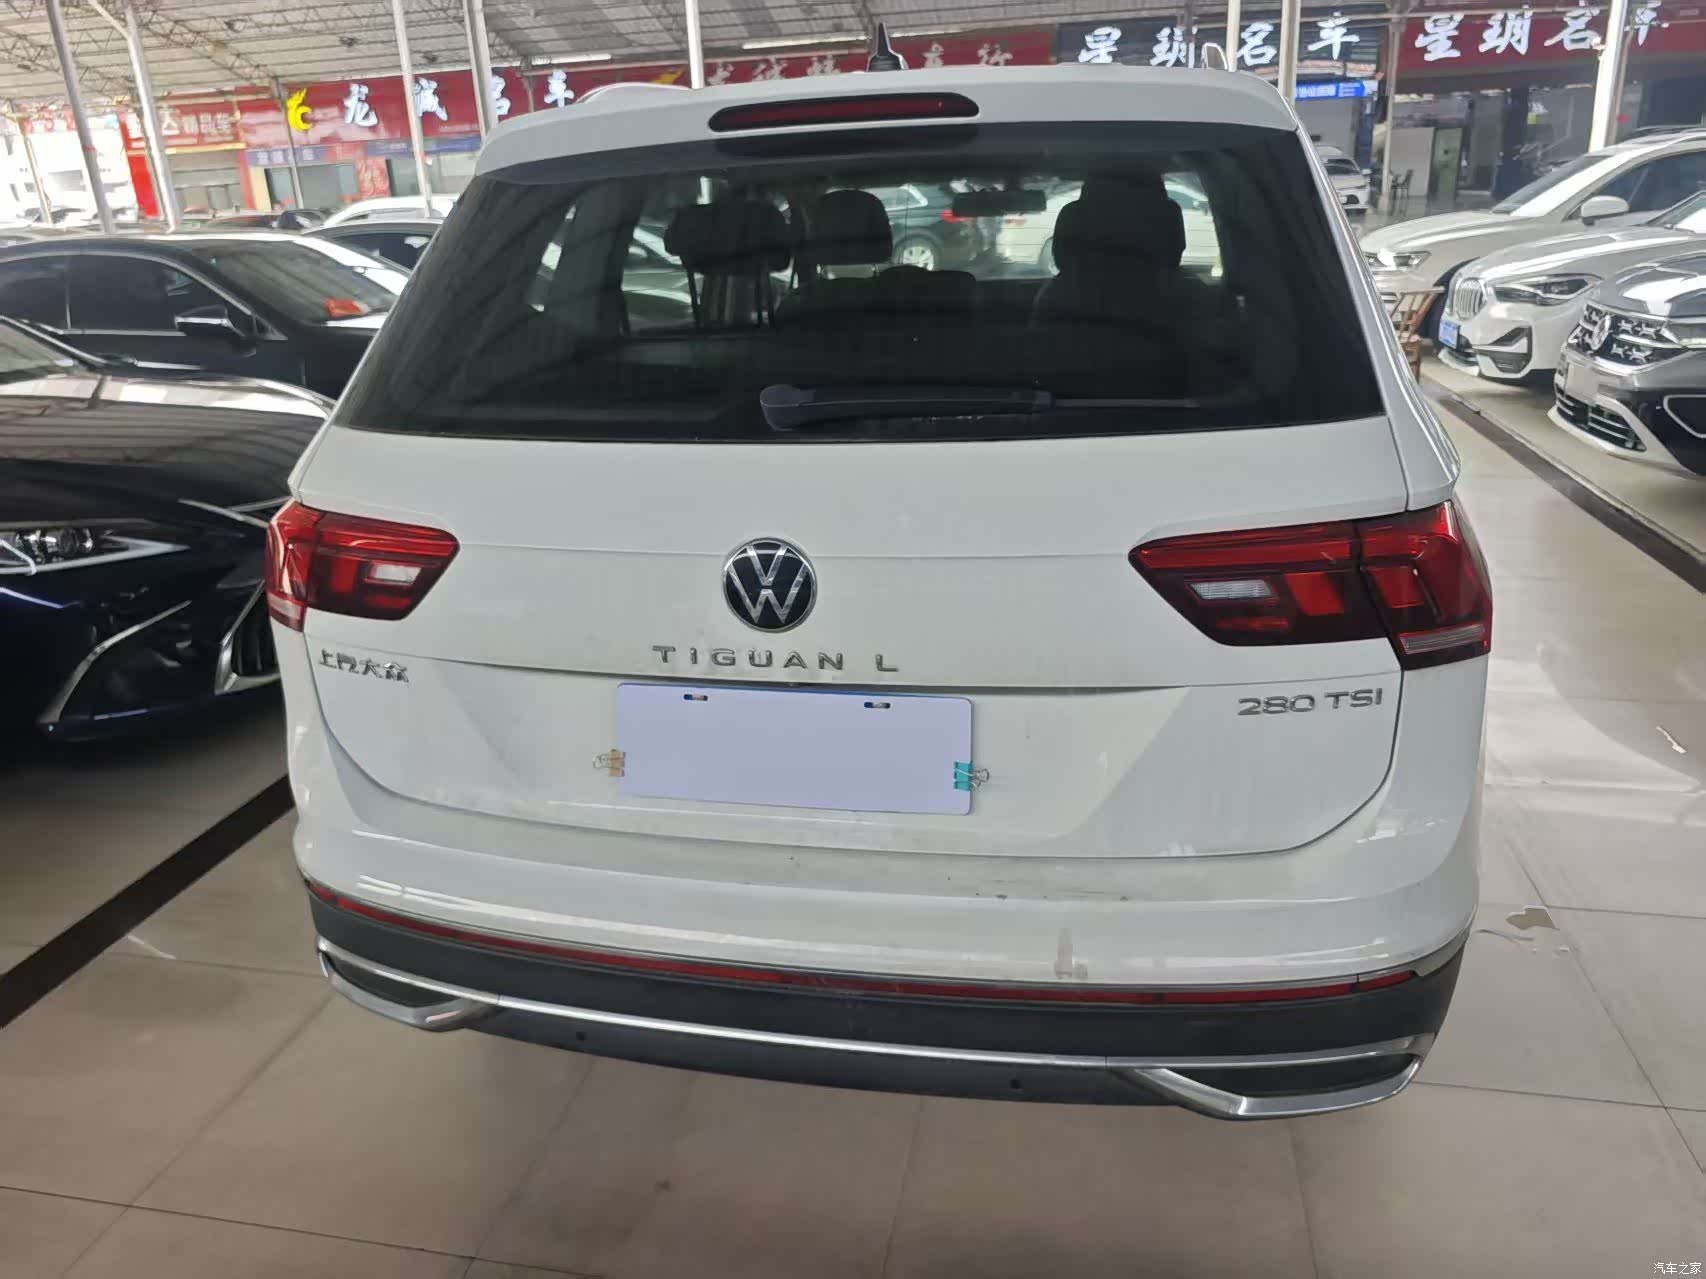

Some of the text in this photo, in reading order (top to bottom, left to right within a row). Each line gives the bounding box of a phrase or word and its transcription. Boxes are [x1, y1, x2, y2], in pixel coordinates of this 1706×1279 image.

[652, 645, 899, 672] TIGUAN L
[1237, 688, 1383, 716] 280 TSI
